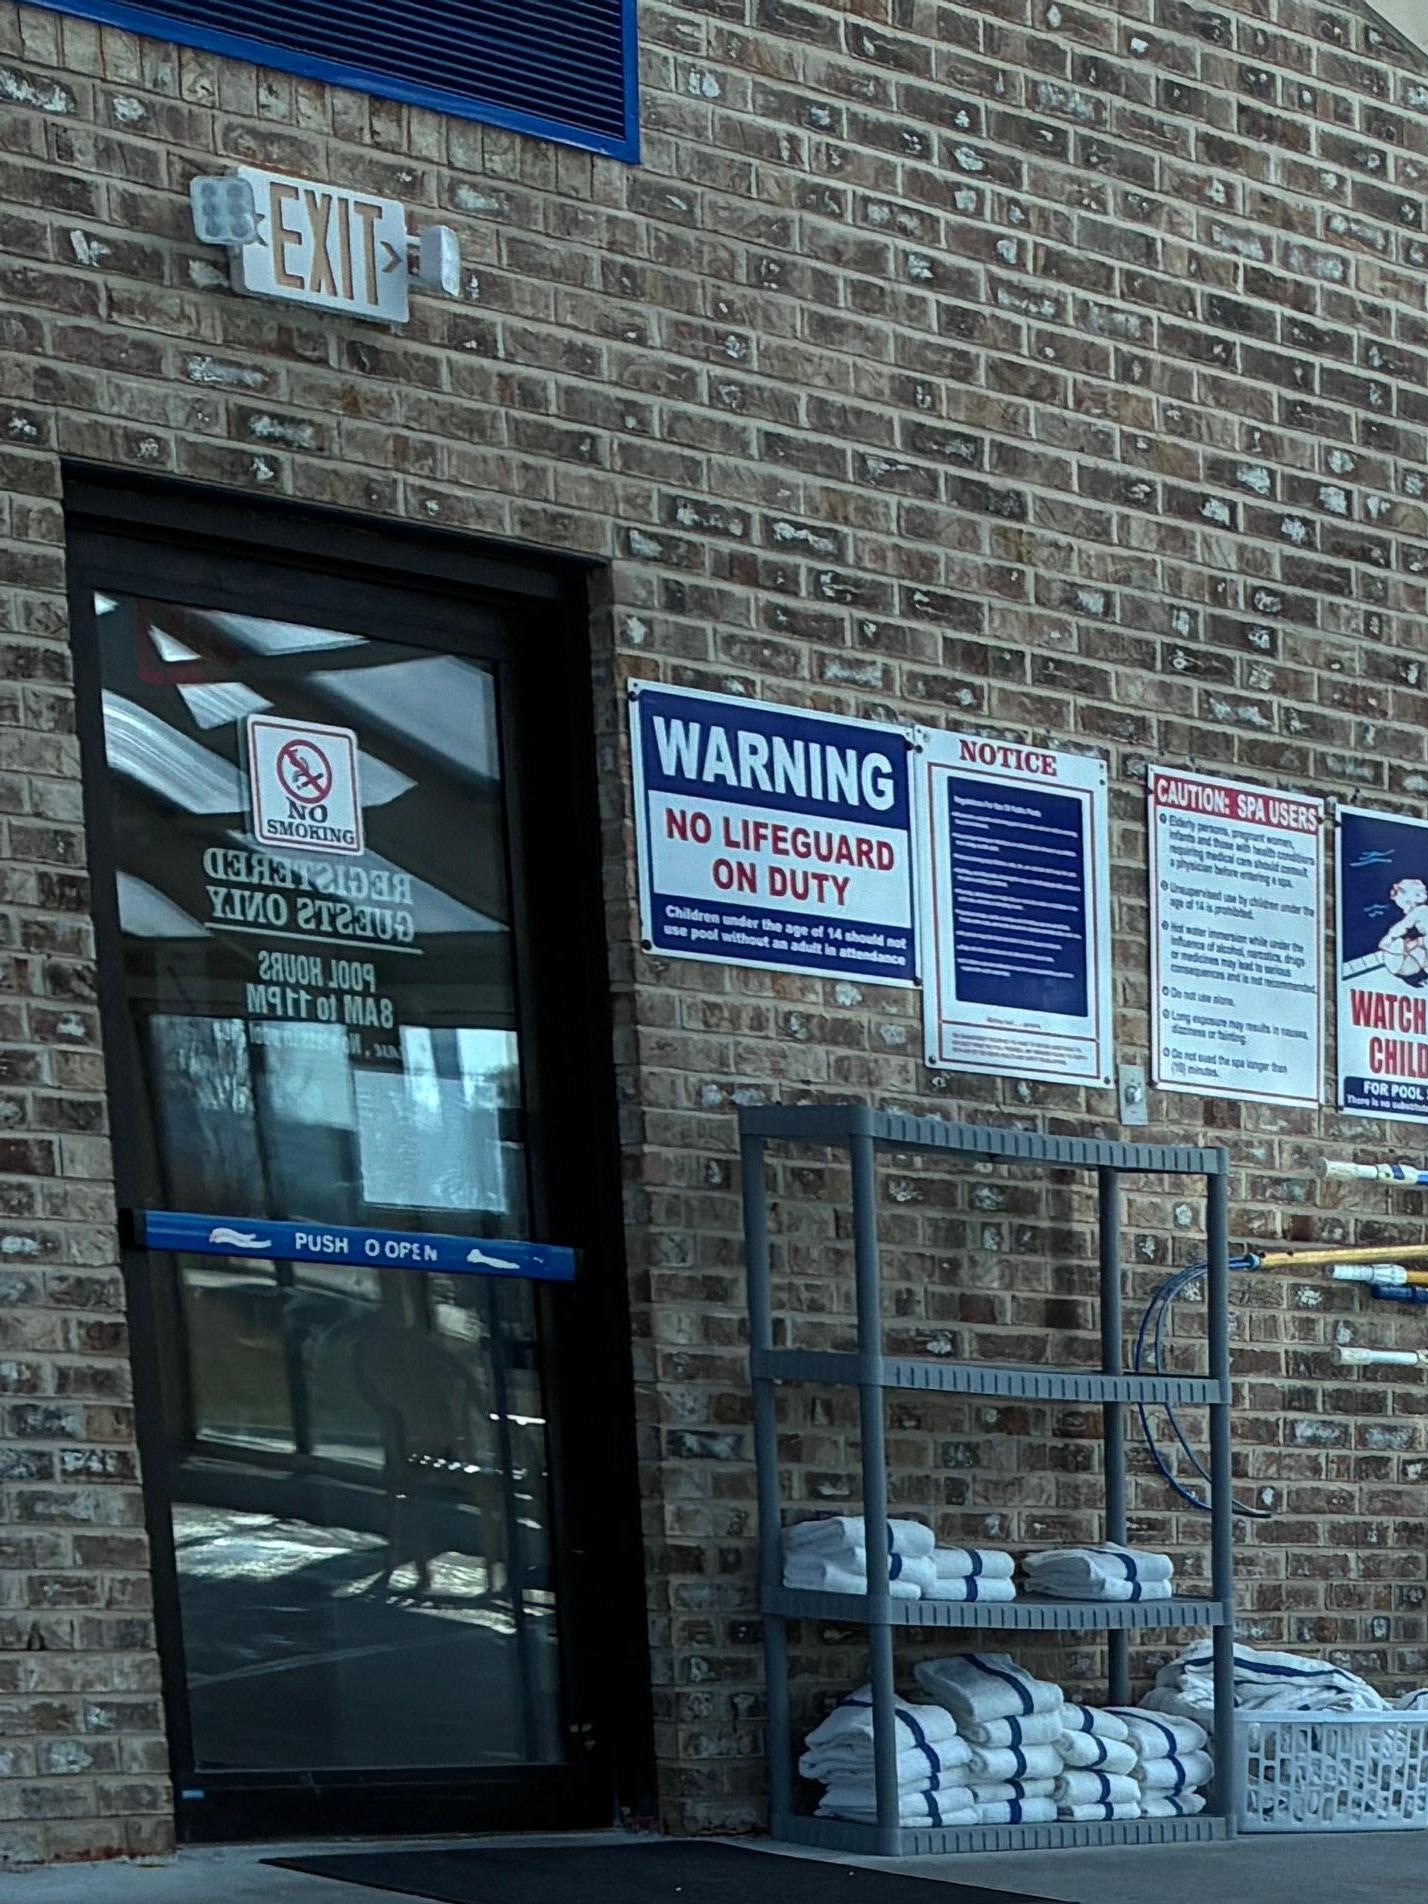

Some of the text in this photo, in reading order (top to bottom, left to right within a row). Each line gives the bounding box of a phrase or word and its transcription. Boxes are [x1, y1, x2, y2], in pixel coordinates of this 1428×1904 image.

[270, 182, 382, 305] EXIT
[653, 716, 894, 811] WARNING
[960, 739, 1057, 776] NOTICE
[286, 797, 328, 823] NO
[1157, 779, 1318, 832] CAUTION: SPA USERS
[267, 819, 354, 845] SMOKING
[666, 808, 894, 871] NO LIFEGUARD
[1198, 835, 1211, 846] and
[1176, 860, 1212, 873] physician
[1206, 851, 1234, 863] medical
[713, 859, 850, 906] ON DUTY
[1170, 882, 1222, 900] Unsupervised
[1249, 896, 1279, 910] children
[1186, 900, 1193, 909] of
[1196, 900, 1203, 910] 14
[665, 905, 906, 949] Children under the age of 14 should not
[1186, 927, 1206, 937] water
[1269, 941, 1290, 950] under
[664, 924, 906, 966] use pool without an adult in attendance
[1207, 943, 1215, 952] of
[1171, 987, 1182, 997] Do
[1184, 991, 1196, 1000] not
[1172, 1010, 1191, 1024] Long
[1351, 989, 1426, 1035] WATCH
[1172, 1048, 1182, 1059] Do
[1185, 1052, 1196, 1061] not
[1218, 1055, 1230, 1066] the
[1232, 1059, 1245, 1068] spa
[1347, 1094, 1369, 1106] There
[1372, 1098, 1379, 1106] is
[1381, 1100, 1390, 1108] no
[1364, 1081, 1388, 1096] FOR
[1391, 1085, 1424, 1100] POOL
[295, 1232, 348, 1254] PUSH
[385, 1240, 438, 1262] OPEN
